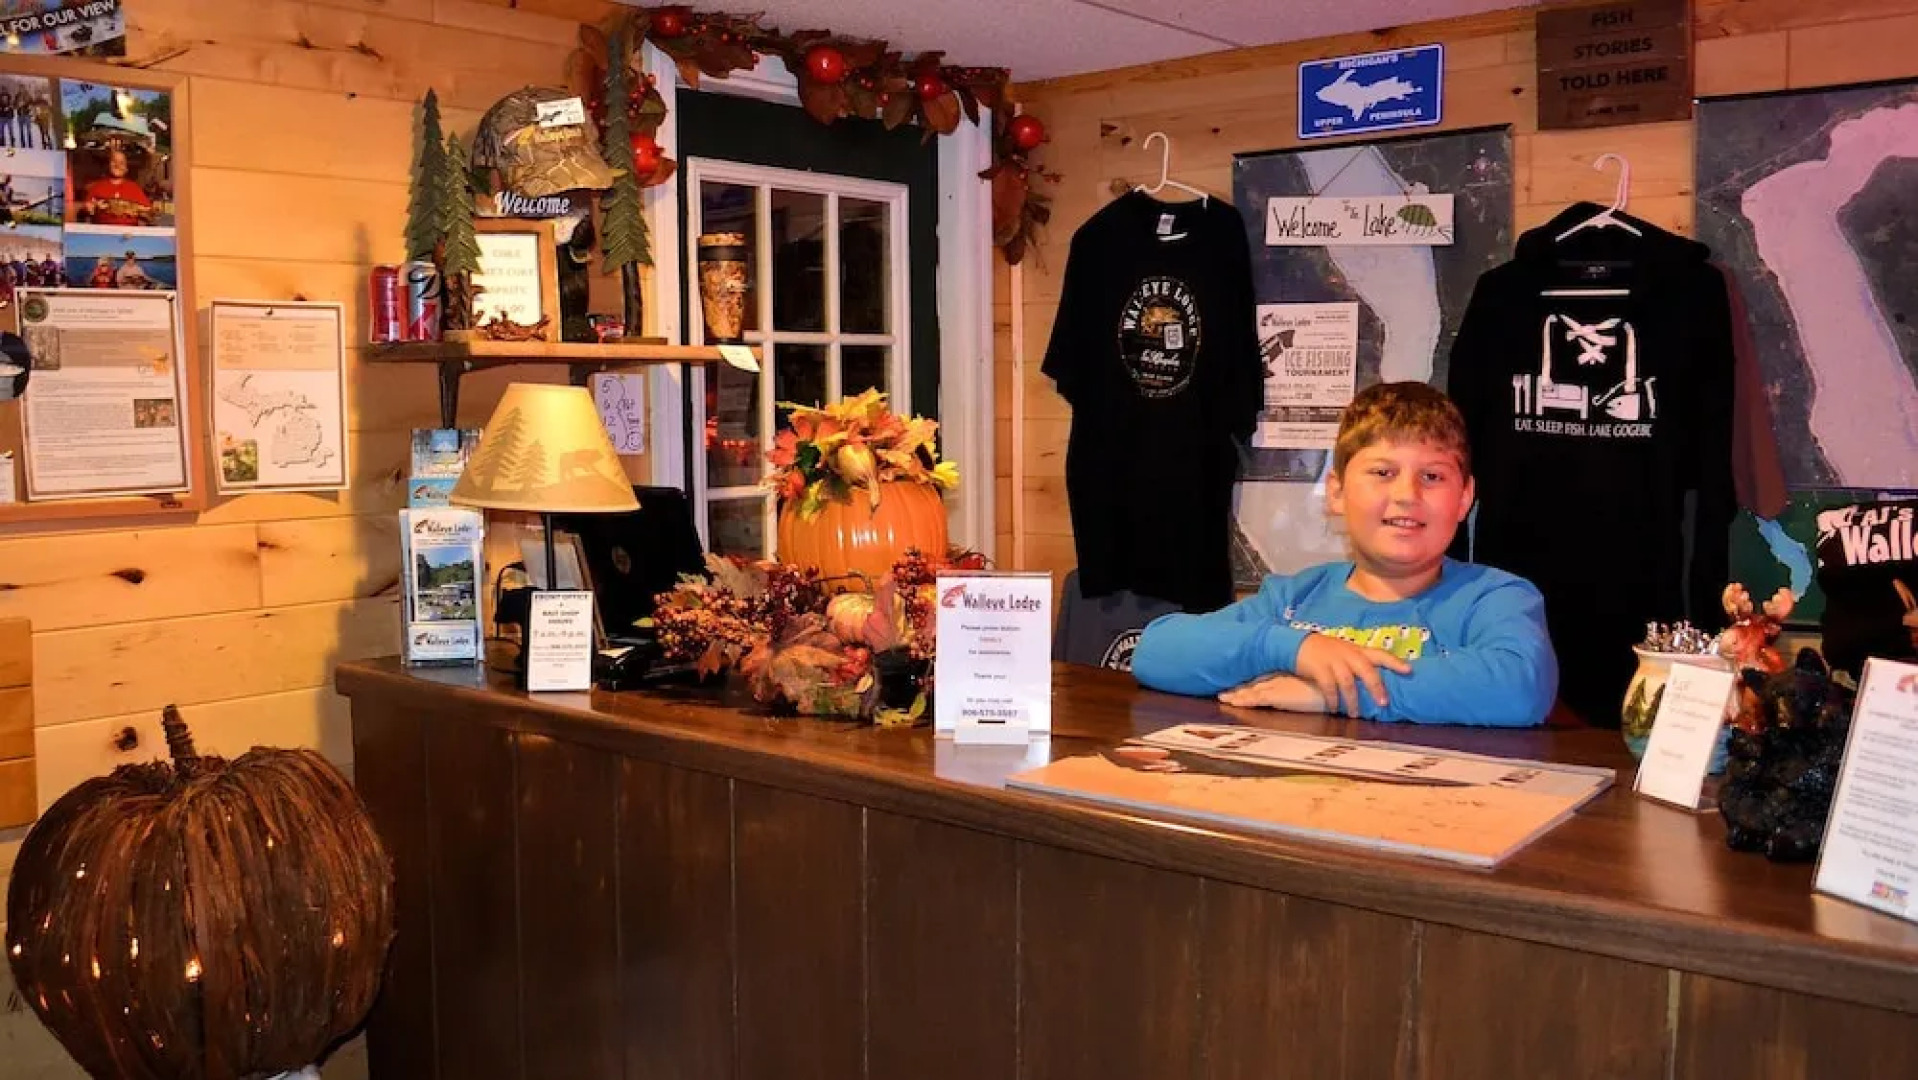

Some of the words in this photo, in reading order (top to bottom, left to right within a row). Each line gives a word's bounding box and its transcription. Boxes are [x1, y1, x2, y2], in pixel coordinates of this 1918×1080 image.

[10, 17, 41, 33] FOR
[44, 9, 77, 26] OUR
[78, 0, 114, 17] VIEW
[1591, 8, 1633, 28] FISH
[1573, 37, 1653, 60] STORIES
[1339, 54, 1398, 69] MICHIGAN'S
[1559, 71, 1610, 92] TOLD
[1616, 66, 1669, 85] HERE
[1314, 117, 1343, 127] UPPER
[1369, 107, 1422, 121] PENINSULA
[495, 191, 570, 215] Welcome
[1273, 204, 1341, 238] Welcome
[1363, 203, 1397, 237] Lake
[1285, 351, 1302, 367] ICE
[1306, 351, 1351, 367] FISHING
[1286, 369, 1350, 377] TOURNAMENT
[962, 593, 1005, 611] Walleye
[1009, 594, 1042, 612] Lodge
